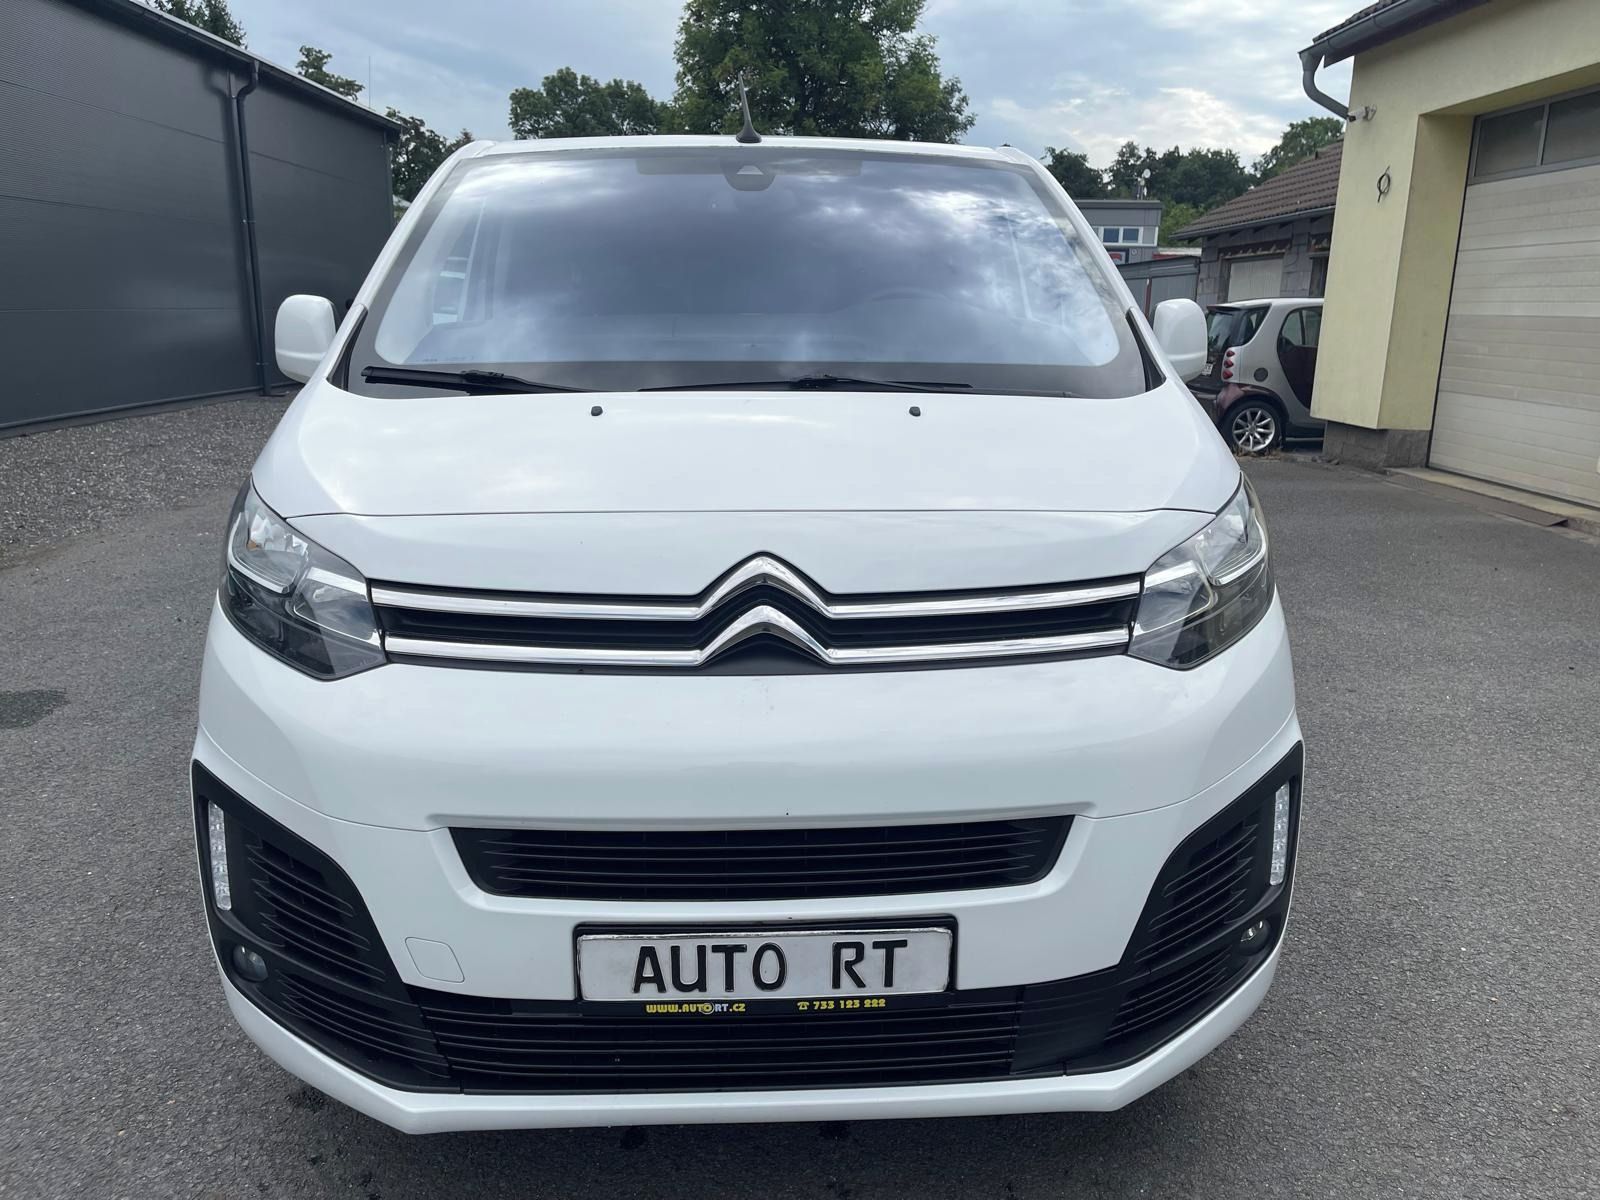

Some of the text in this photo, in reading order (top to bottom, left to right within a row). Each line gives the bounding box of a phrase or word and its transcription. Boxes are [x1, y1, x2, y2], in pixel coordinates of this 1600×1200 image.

[632, 938, 909, 994] AUTO RT
[813, 998, 886, 1010] 733 123 222
